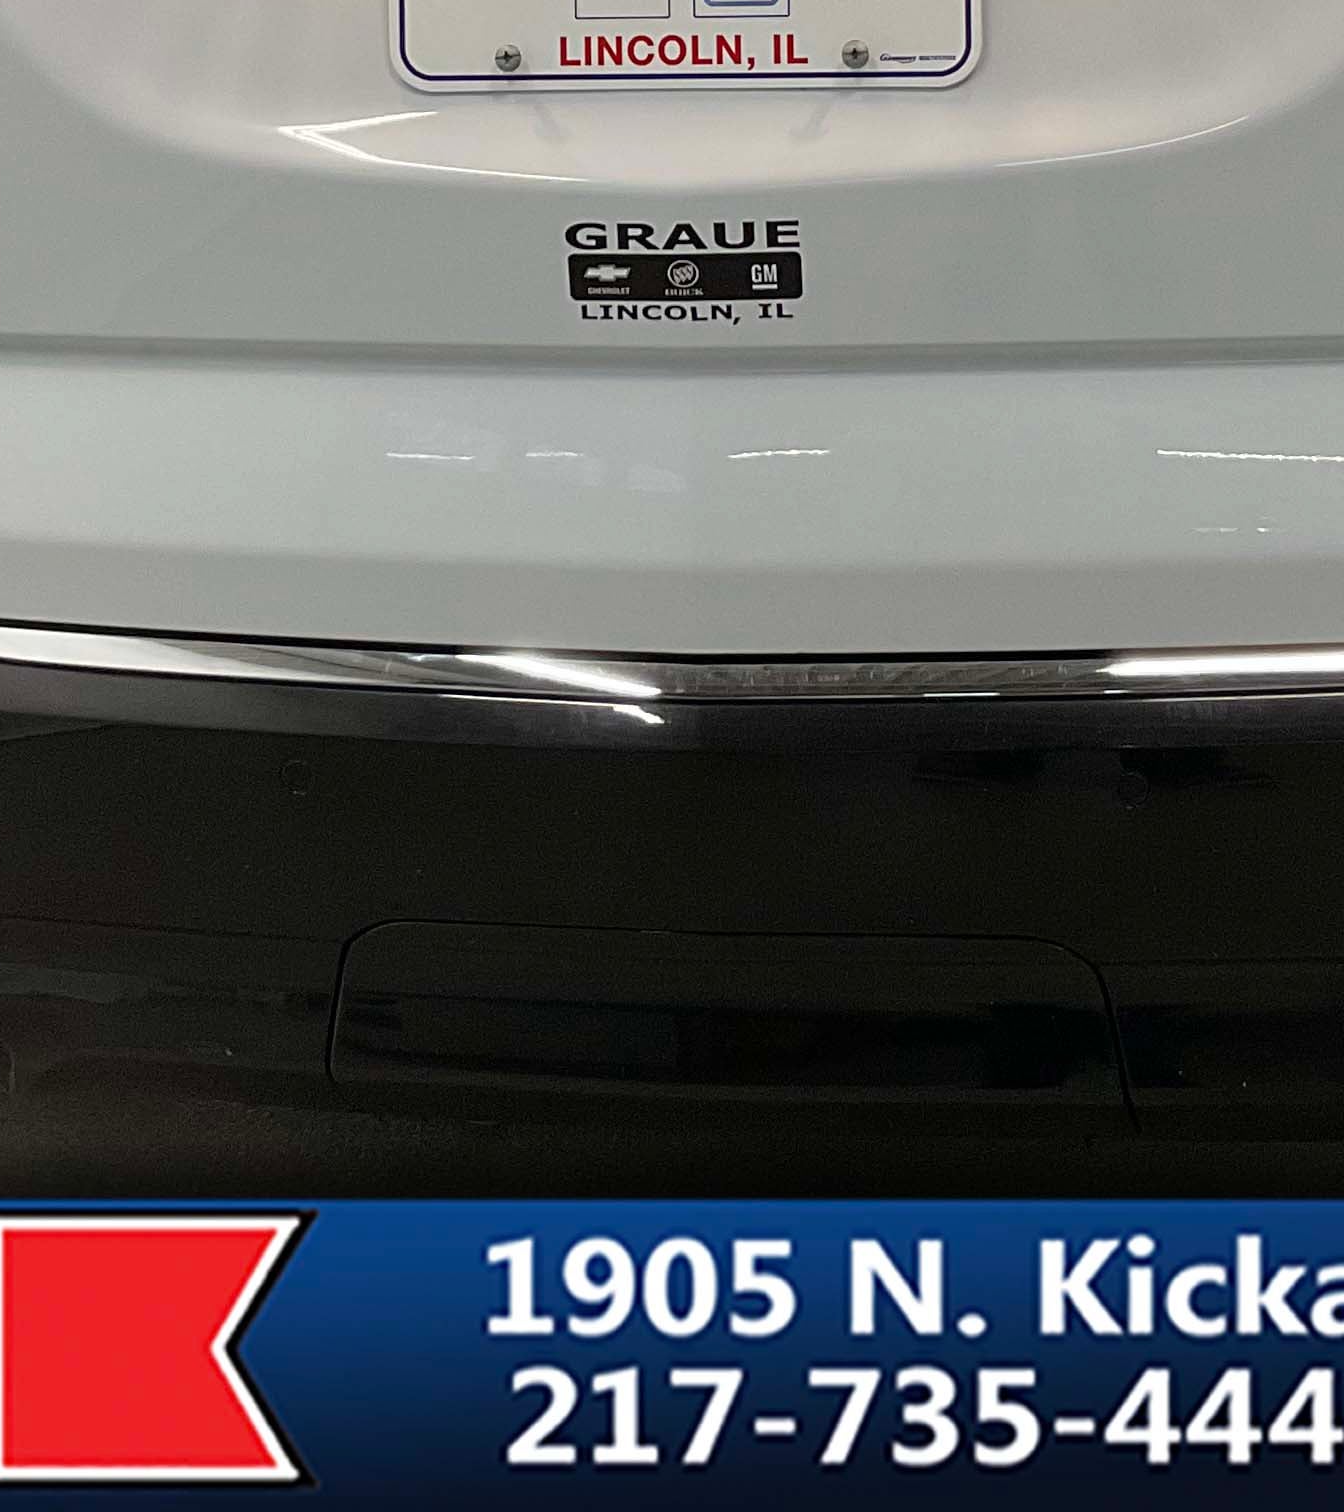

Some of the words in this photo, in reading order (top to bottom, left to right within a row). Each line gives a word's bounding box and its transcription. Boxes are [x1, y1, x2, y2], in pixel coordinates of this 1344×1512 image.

[559, 35, 757, 70] LINCOLN,
[772, 34, 809, 65] IL
[564, 219, 801, 251] GRAUE
[751, 263, 778, 284] GM
[580, 303, 741, 326] LINCOLN,
[757, 302, 795, 319] IL
